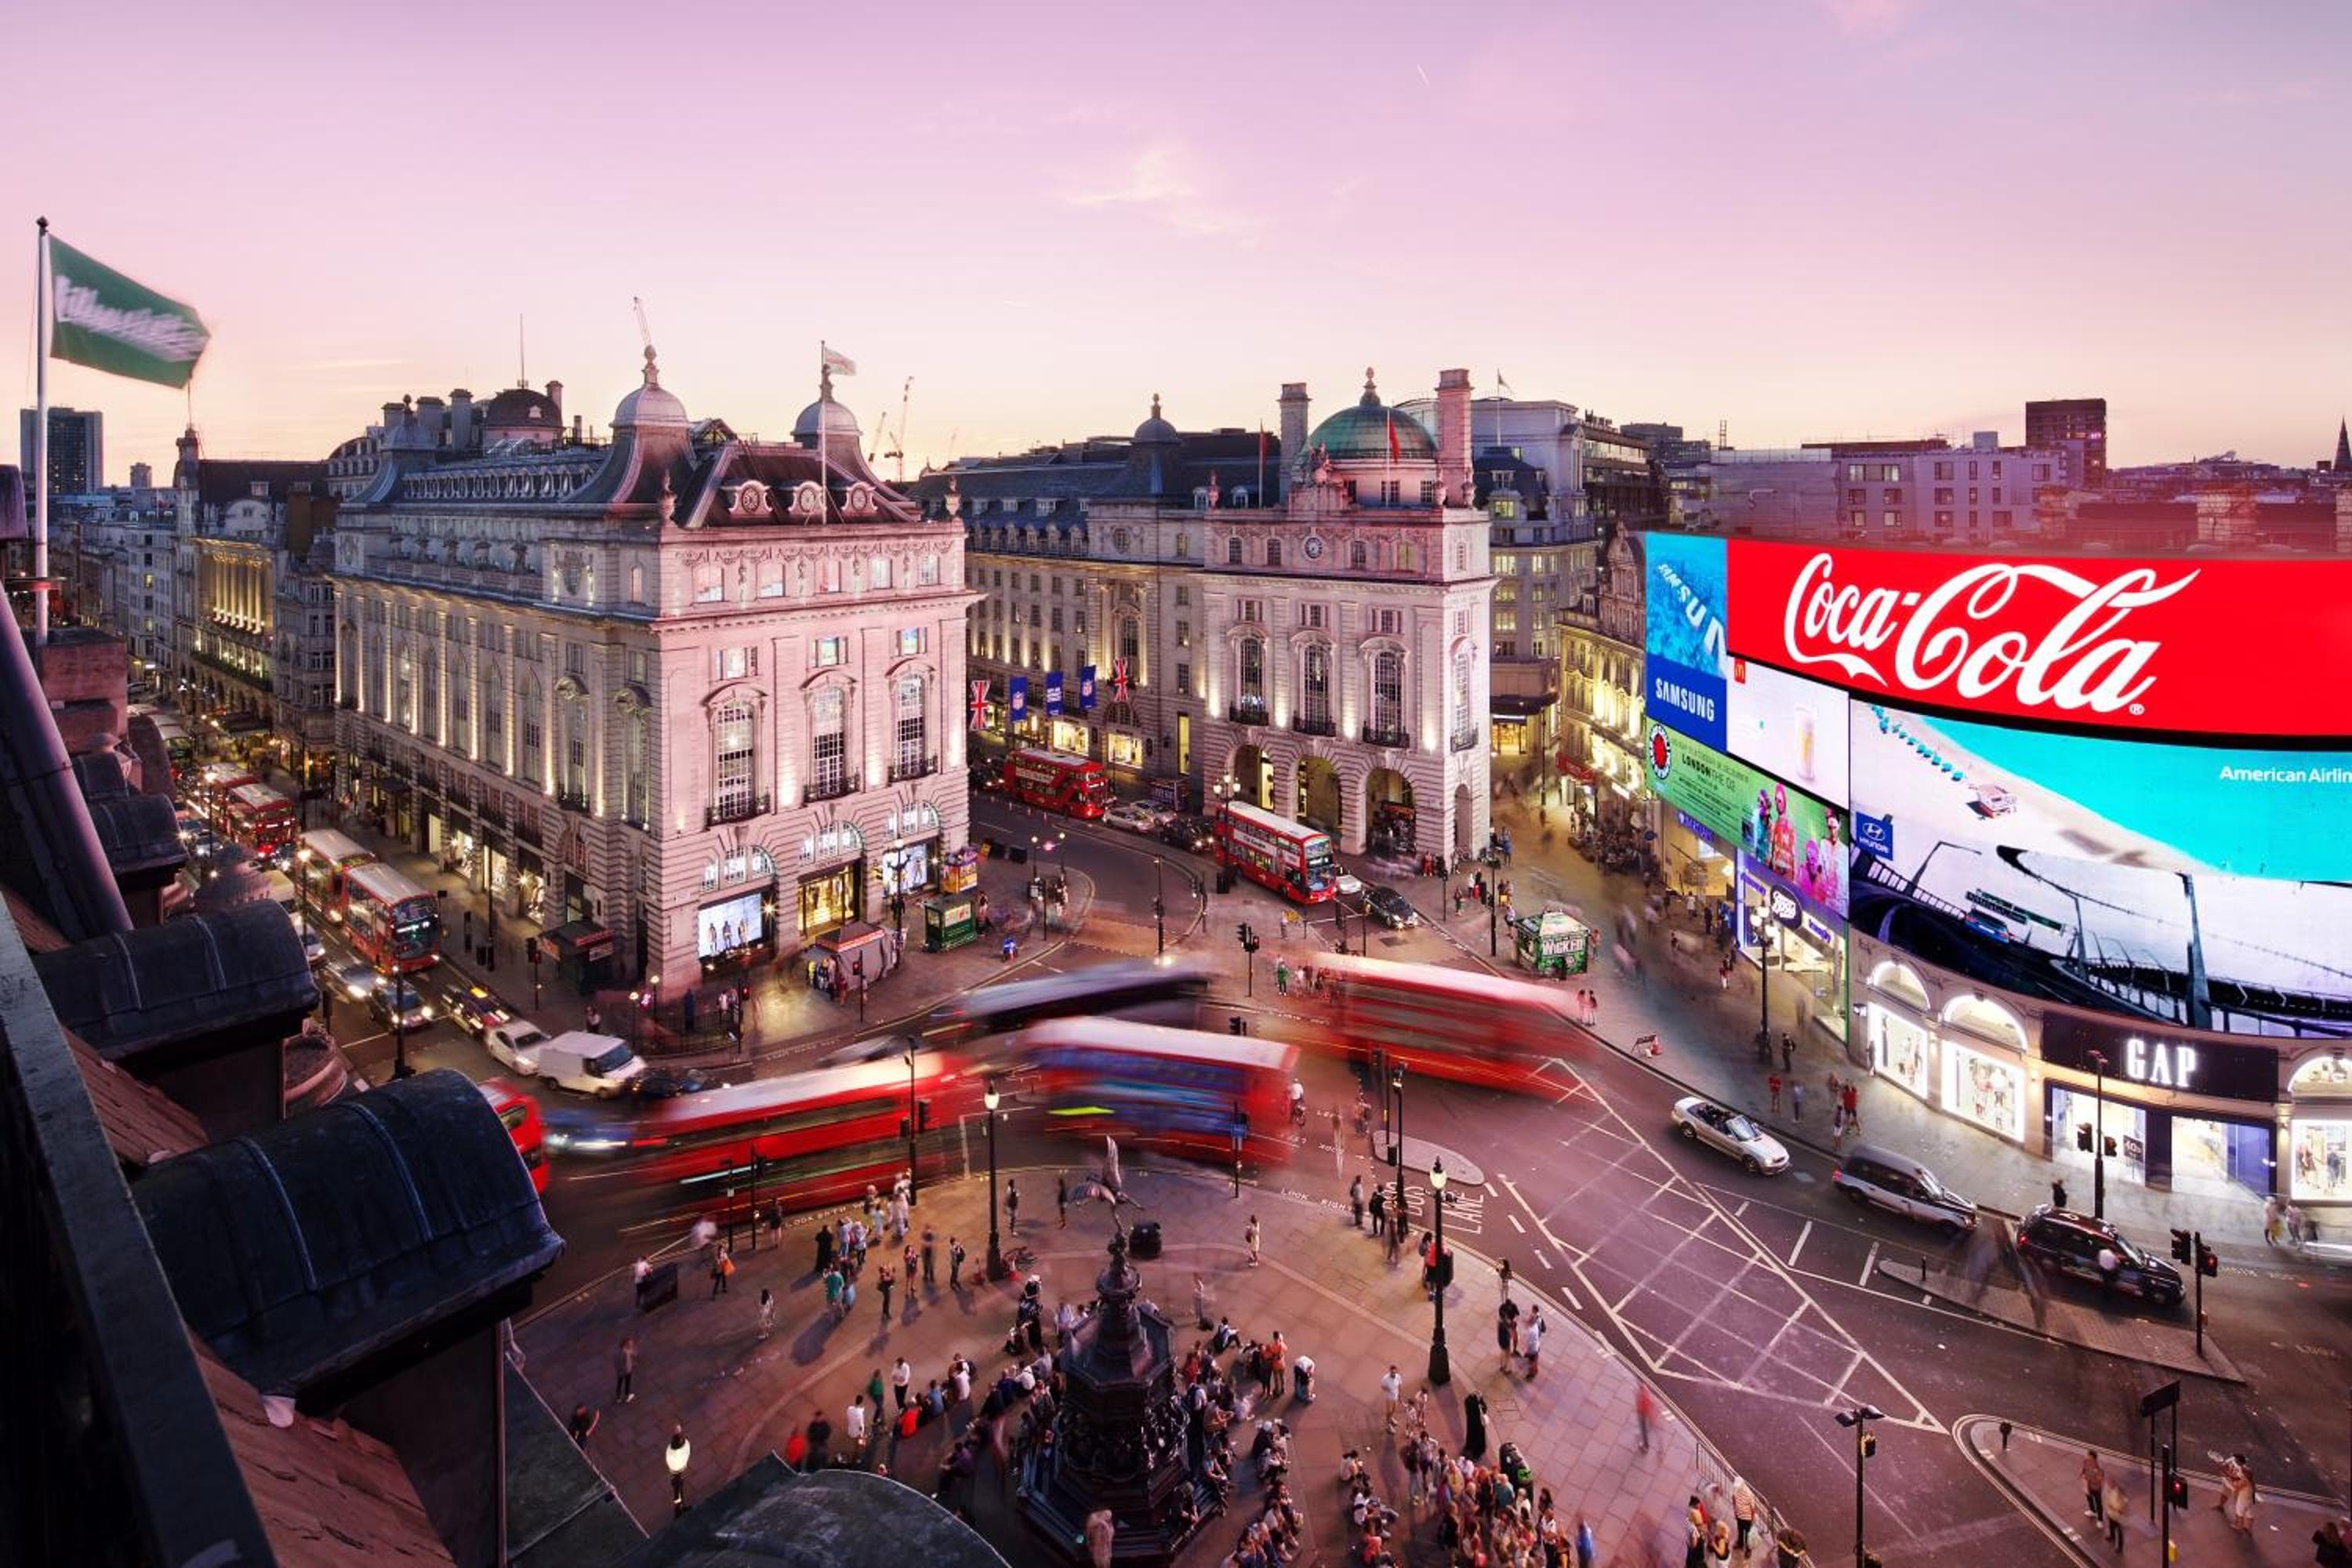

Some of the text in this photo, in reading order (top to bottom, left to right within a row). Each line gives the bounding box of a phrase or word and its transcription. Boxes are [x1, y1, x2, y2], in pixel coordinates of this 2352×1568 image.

[1655, 677, 1715, 722] SAMSUNG
[1682, 753, 1711, 778] LONDON
[2220, 766, 2307, 783] American
[1542, 938, 1582, 955] WICKED
[2126, 1038, 2198, 1087] GAP
[1280, 1187, 1308, 1201] LOOK
[785, 1216, 815, 1228] LOOK
[1441, 1191, 1485, 1235] LANE
